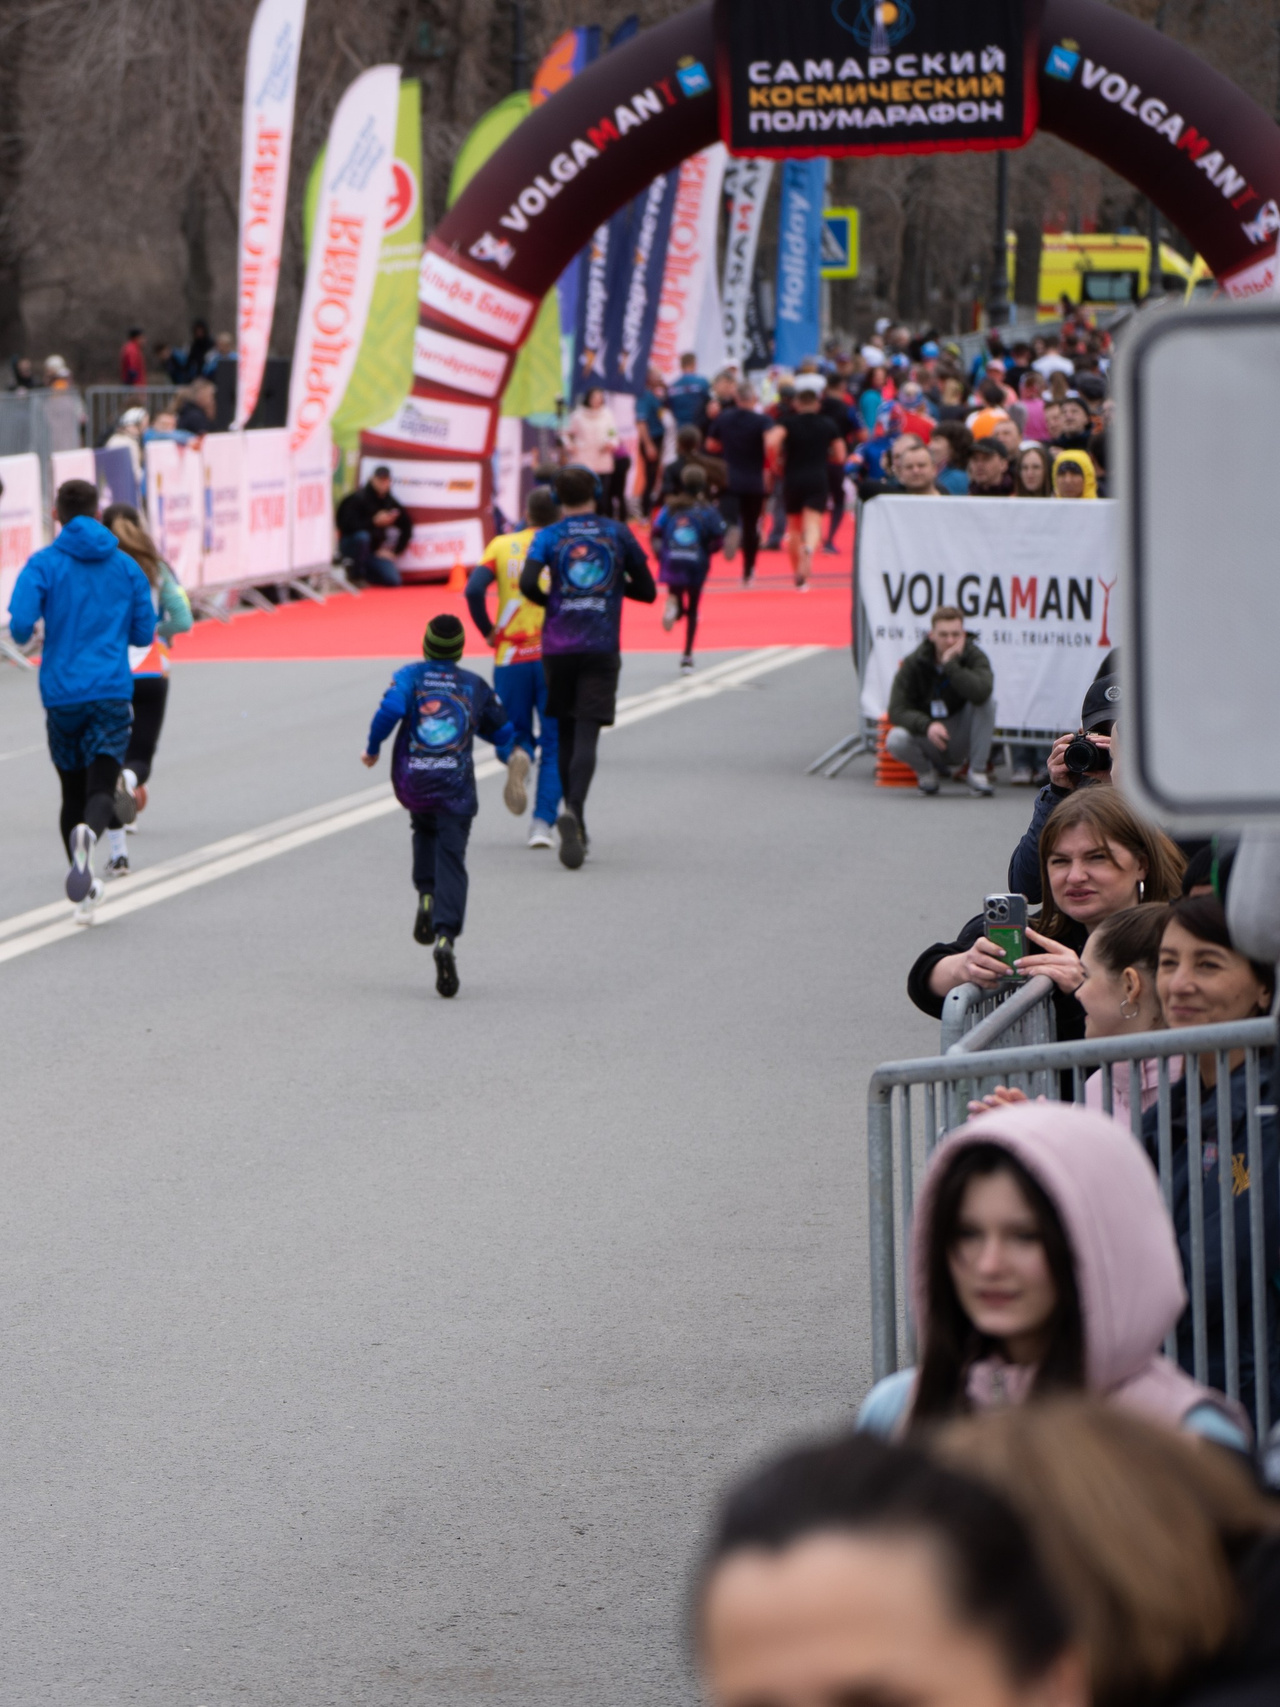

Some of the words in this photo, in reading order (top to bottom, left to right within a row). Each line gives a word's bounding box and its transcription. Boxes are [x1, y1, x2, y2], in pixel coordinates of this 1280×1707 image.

[748, 45, 1006, 84] САМАРСКИЙ
[749, 72, 1005, 108] КОСМИЧЕСКИЙ
[749, 100, 1004, 133] ПОЛУМАРАФОН
[1081, 58, 1246, 200] VOLGAMAN
[499, 87, 664, 232] VOLGAMAN
[780, 191, 812, 324] Holiday
[882, 571, 1093, 621] VOLGAMAN
[1021, 632, 1093, 647] TRIATHLON
